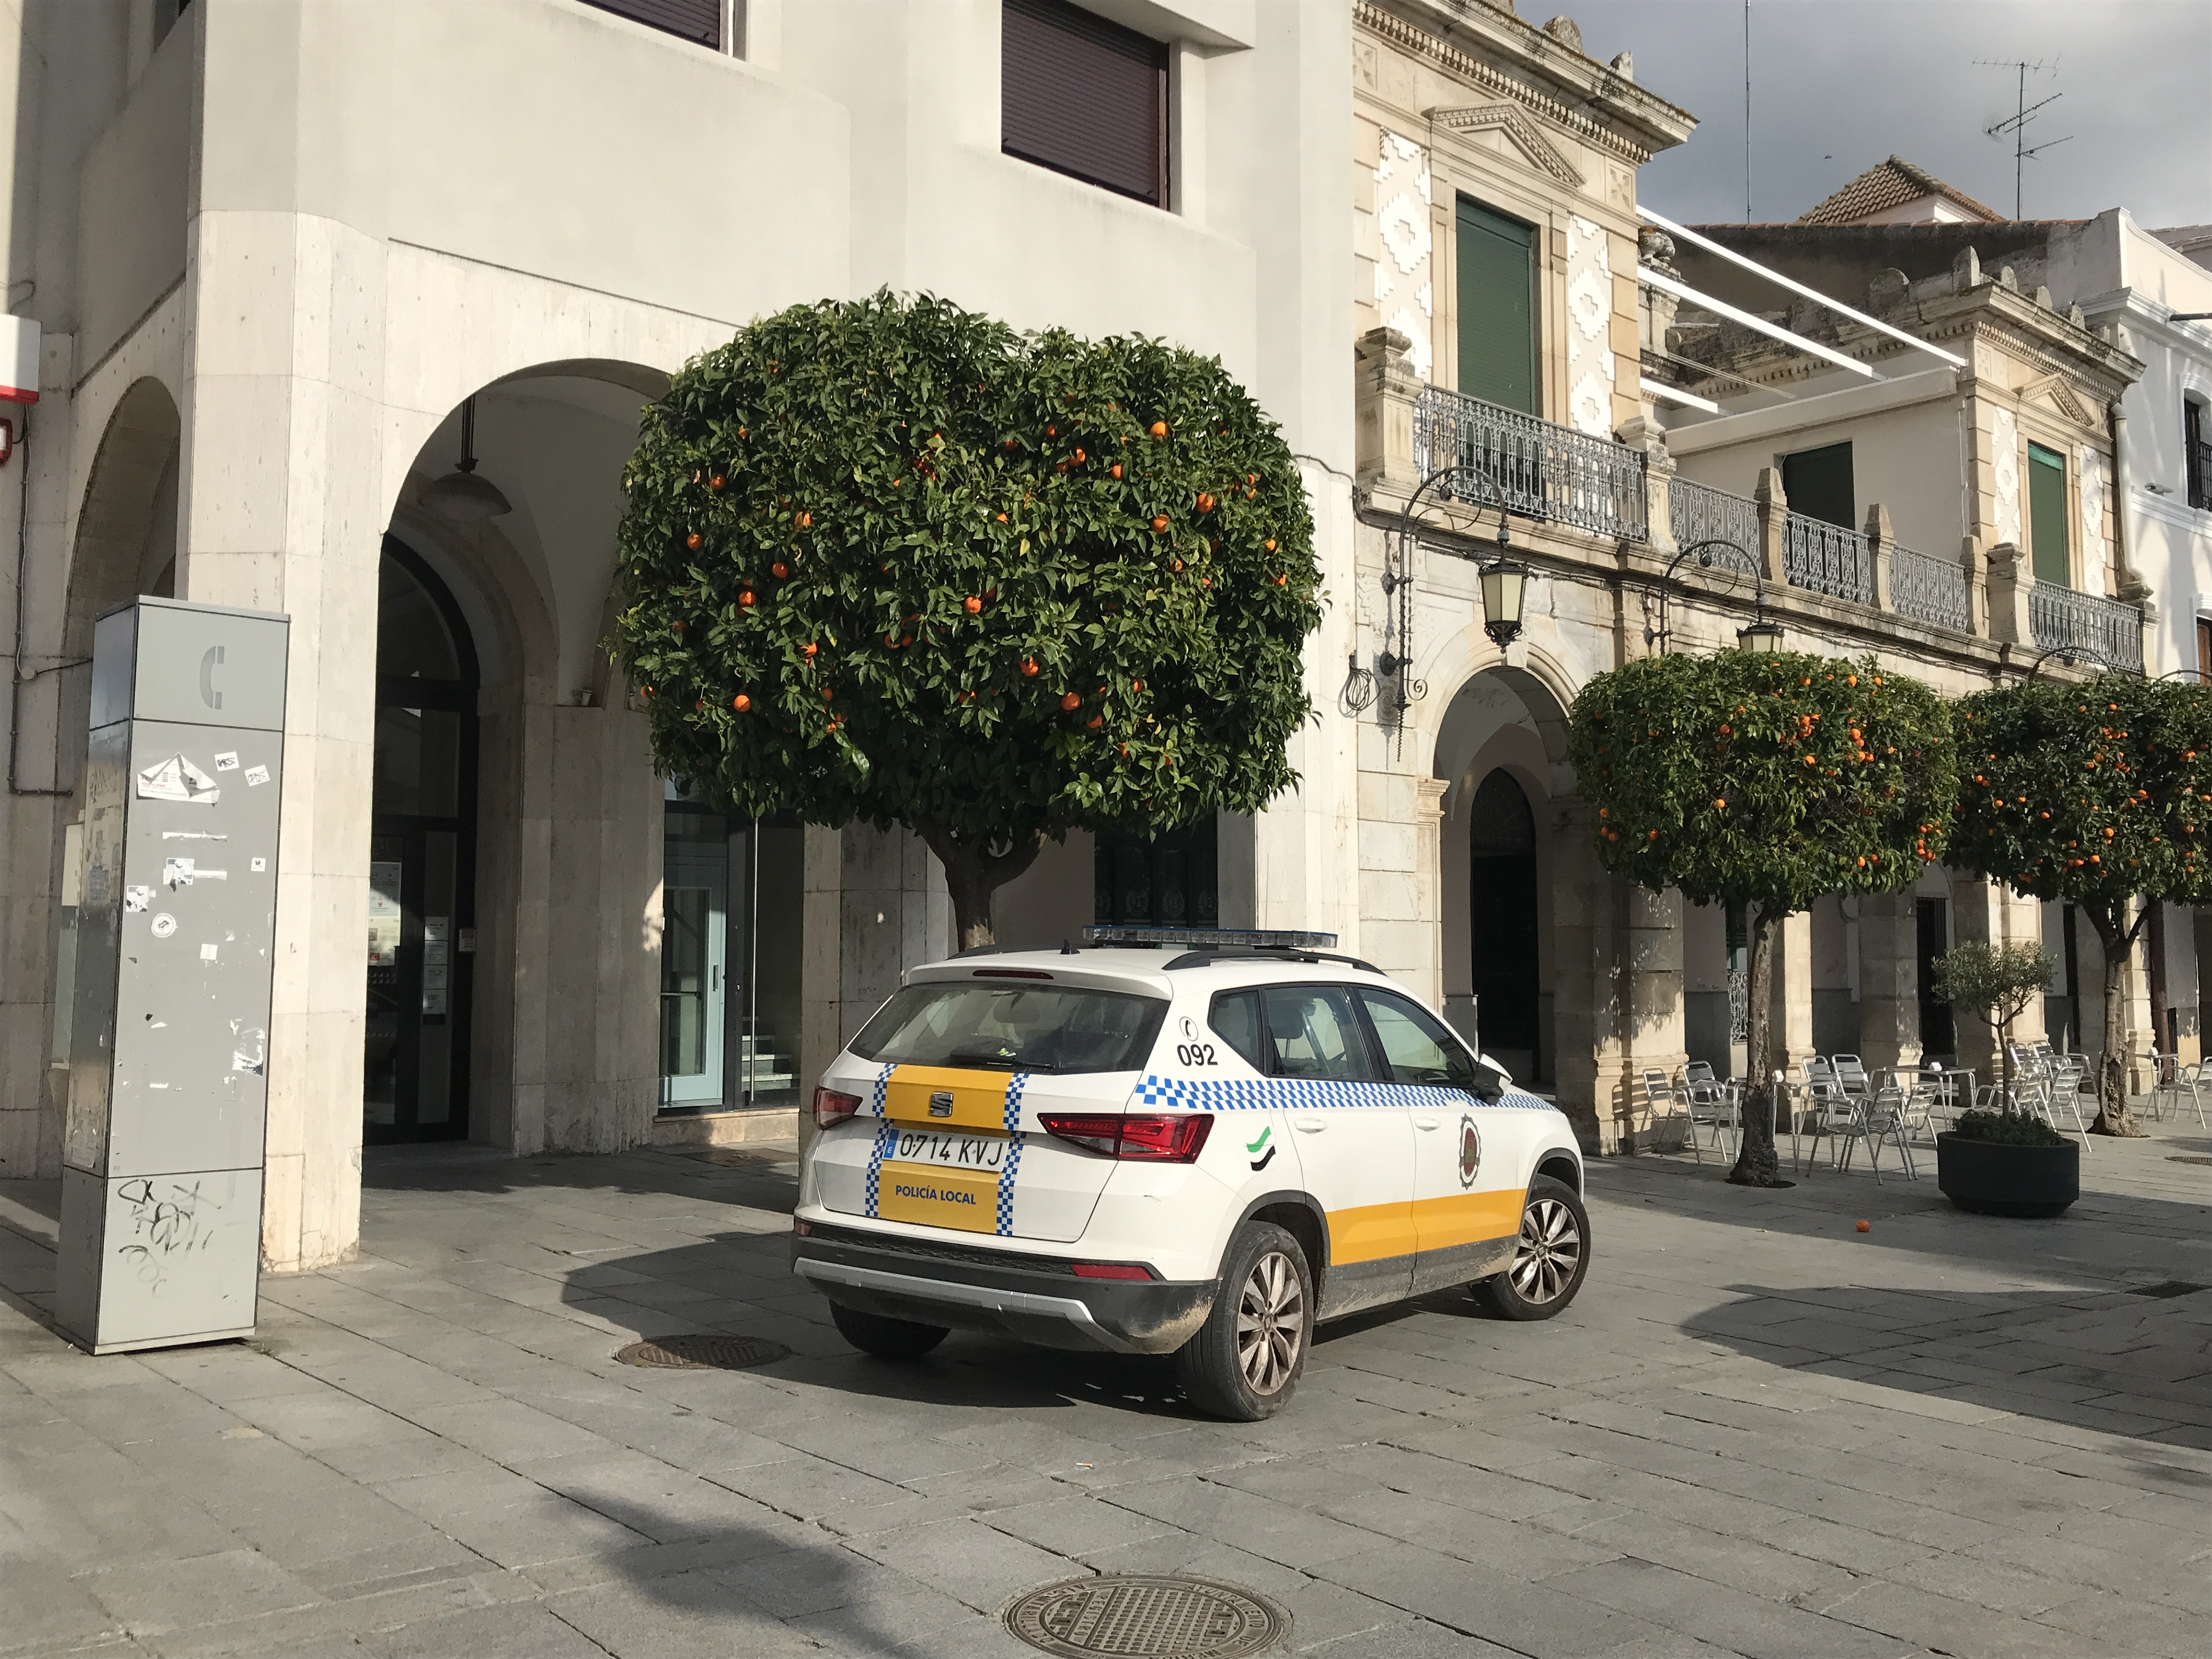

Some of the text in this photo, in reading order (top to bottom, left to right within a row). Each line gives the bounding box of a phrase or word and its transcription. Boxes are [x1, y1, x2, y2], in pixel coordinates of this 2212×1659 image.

[1177, 1043, 1218, 1066] 092
[900, 1133, 1003, 1166] 0714 KVJ
[895, 1184, 977, 1205] POLICÍA LOCAL
[1074, 1595, 1108, 1636] REGISTRO
[1185, 1584, 1266, 1628] AYUNTAMIENTO
